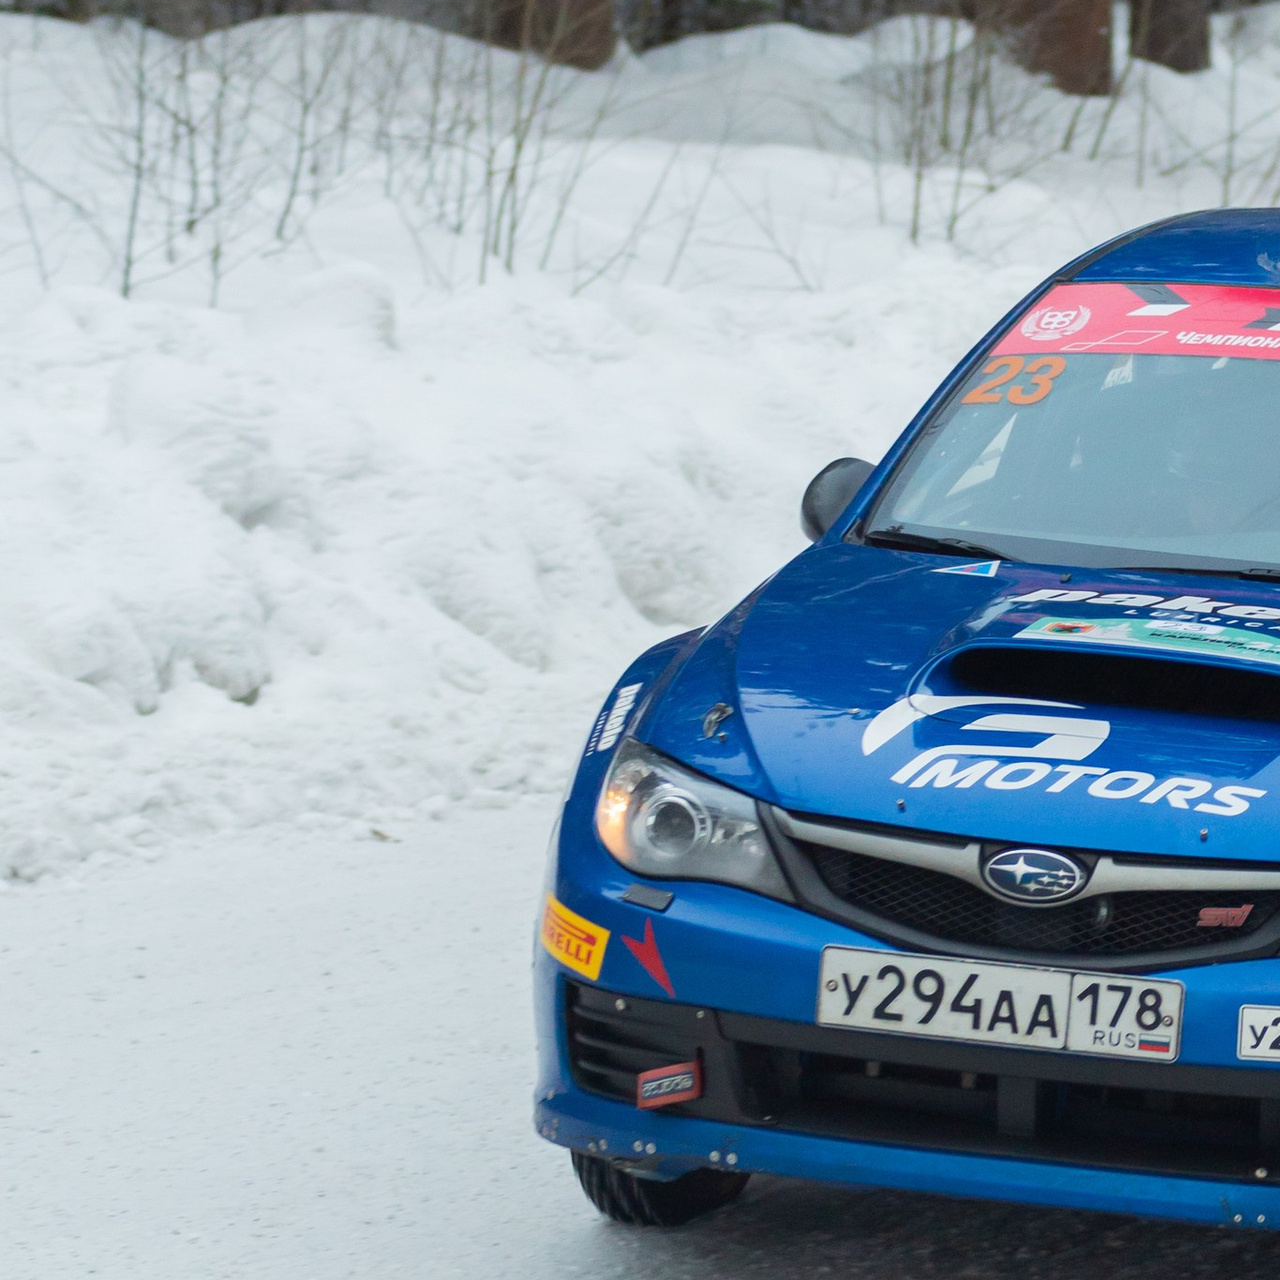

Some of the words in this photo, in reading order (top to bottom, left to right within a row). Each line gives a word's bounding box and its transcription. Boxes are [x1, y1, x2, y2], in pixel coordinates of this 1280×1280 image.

[962, 356, 1067, 406] 23
[596, 682, 645, 752] pakelo
[908, 758, 1268, 817] MOTORS
[1076, 982, 1163, 1031] 178
[1092, 1030, 1137, 1048] RUS
